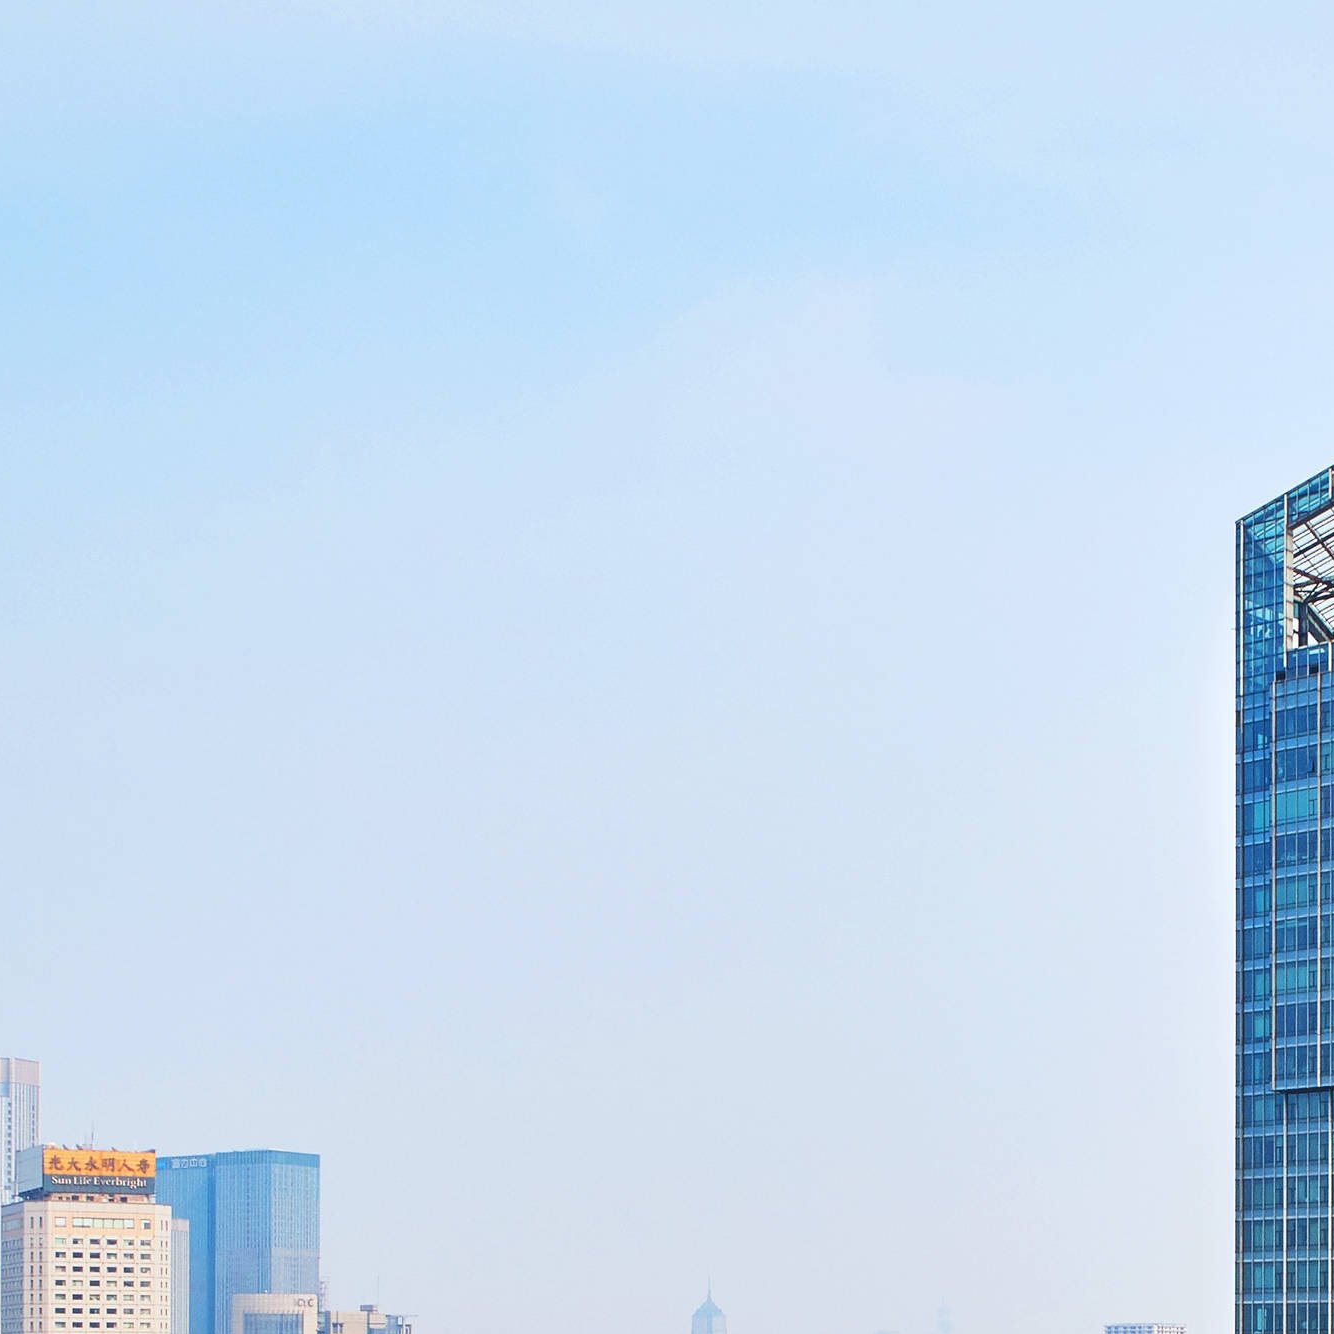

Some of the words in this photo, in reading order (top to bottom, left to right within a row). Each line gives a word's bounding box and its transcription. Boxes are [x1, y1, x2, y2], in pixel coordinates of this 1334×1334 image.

[51, 1176, 71, 1185] Sun
[73, 1176, 92, 1186] Life
[93, 1176, 147, 1189] Everbright
